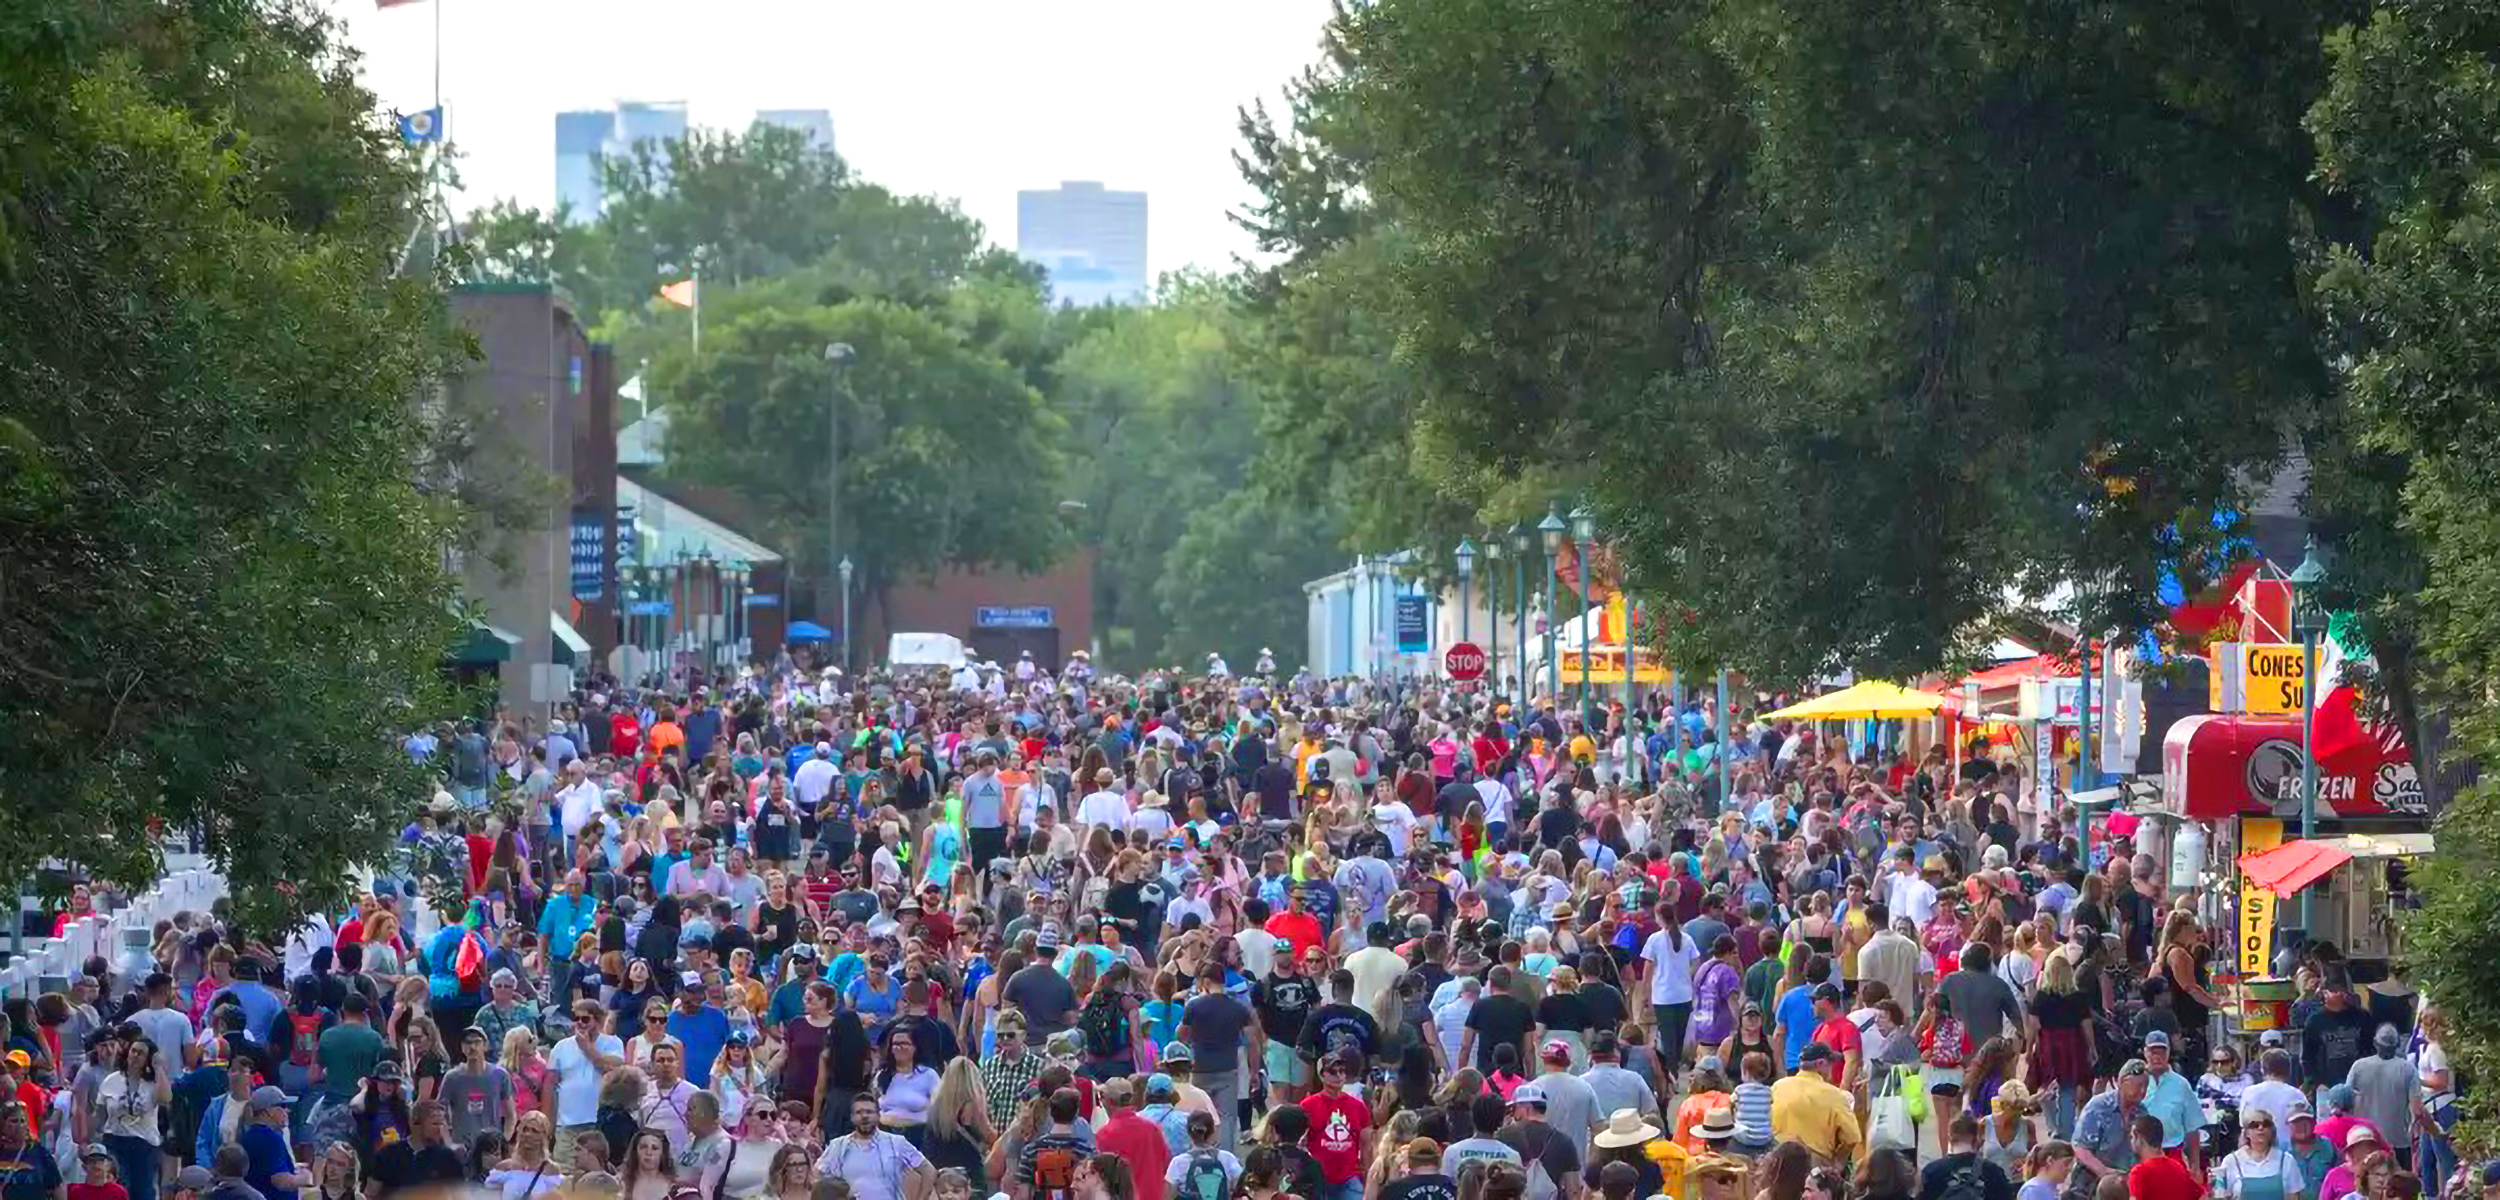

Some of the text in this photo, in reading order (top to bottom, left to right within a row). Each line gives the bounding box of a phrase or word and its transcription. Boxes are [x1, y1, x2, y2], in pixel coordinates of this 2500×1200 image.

[1447, 654, 1483, 671] STOP
[2249, 650, 2303, 677] CONES
[2278, 776, 2356, 799] FRZEN
[2247, 898, 2263, 969] STOP
